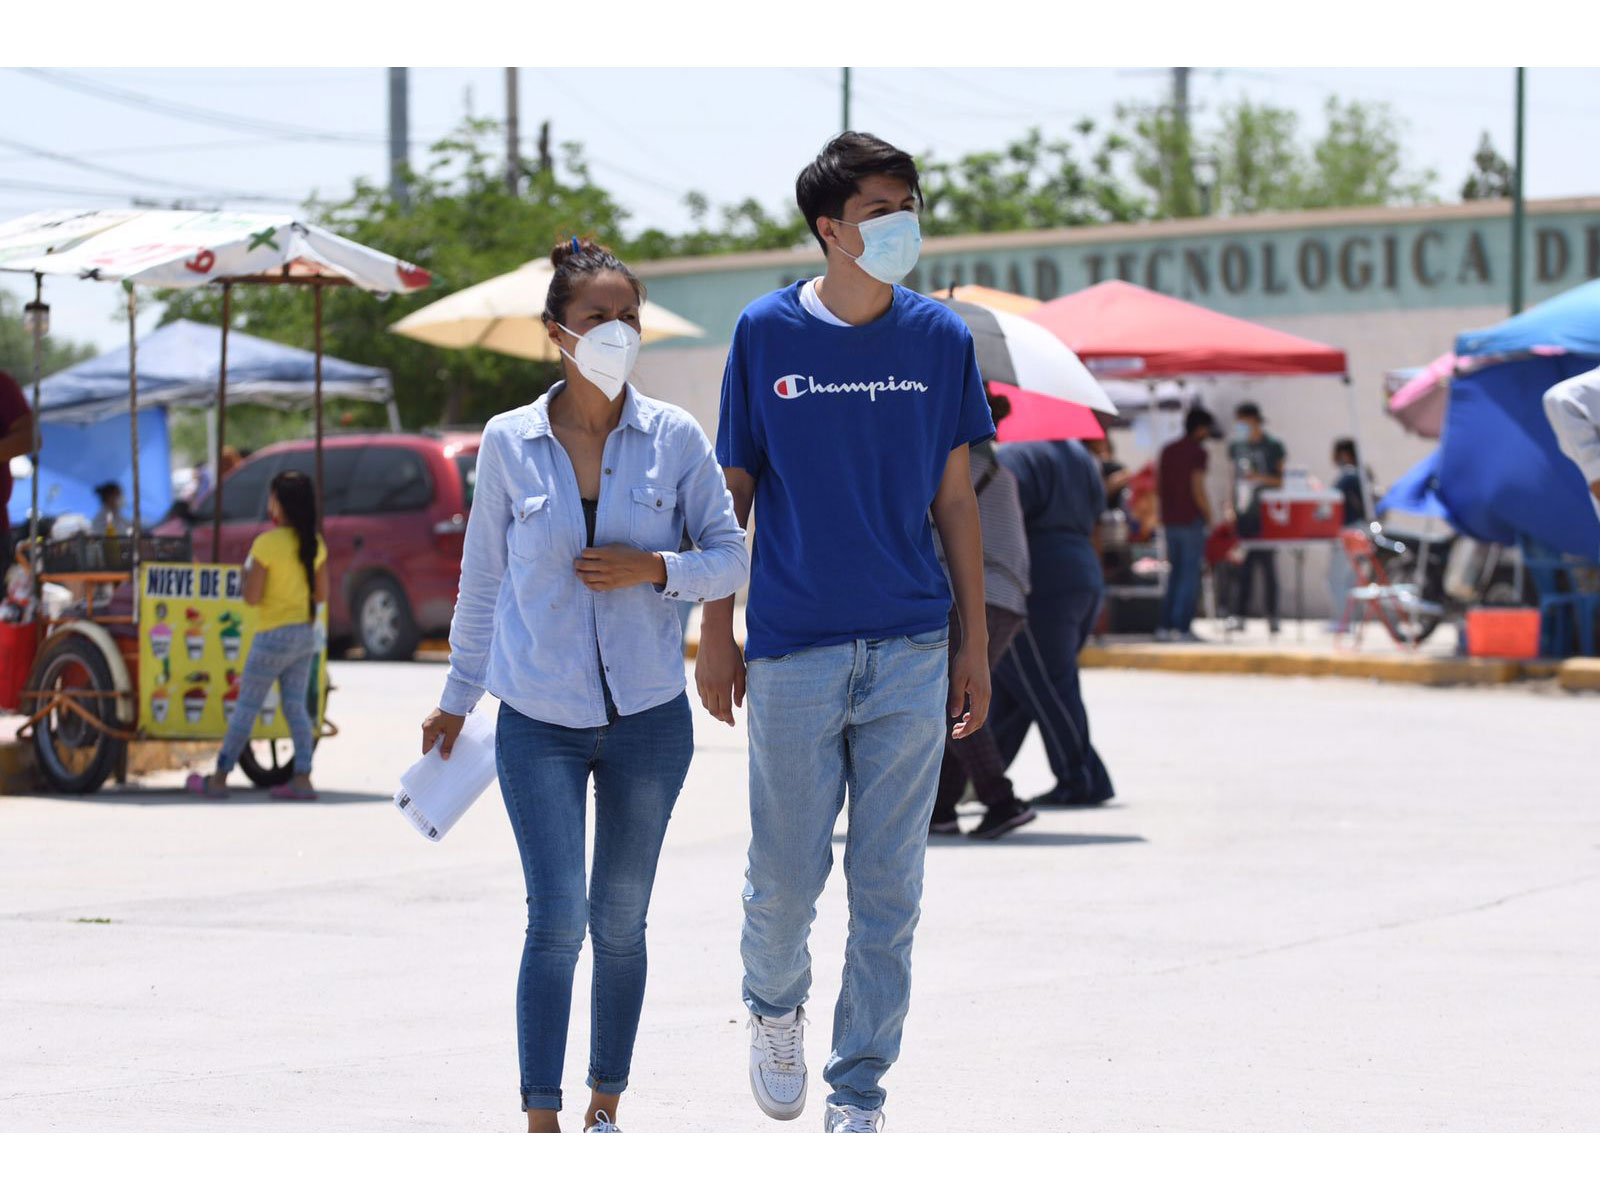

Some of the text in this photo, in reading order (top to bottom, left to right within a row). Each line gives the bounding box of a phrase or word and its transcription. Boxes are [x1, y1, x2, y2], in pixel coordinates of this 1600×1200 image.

[773, 374, 928, 402] Champion
[147, 568, 194, 597] NIEVE
[200, 569, 219, 597] DE
